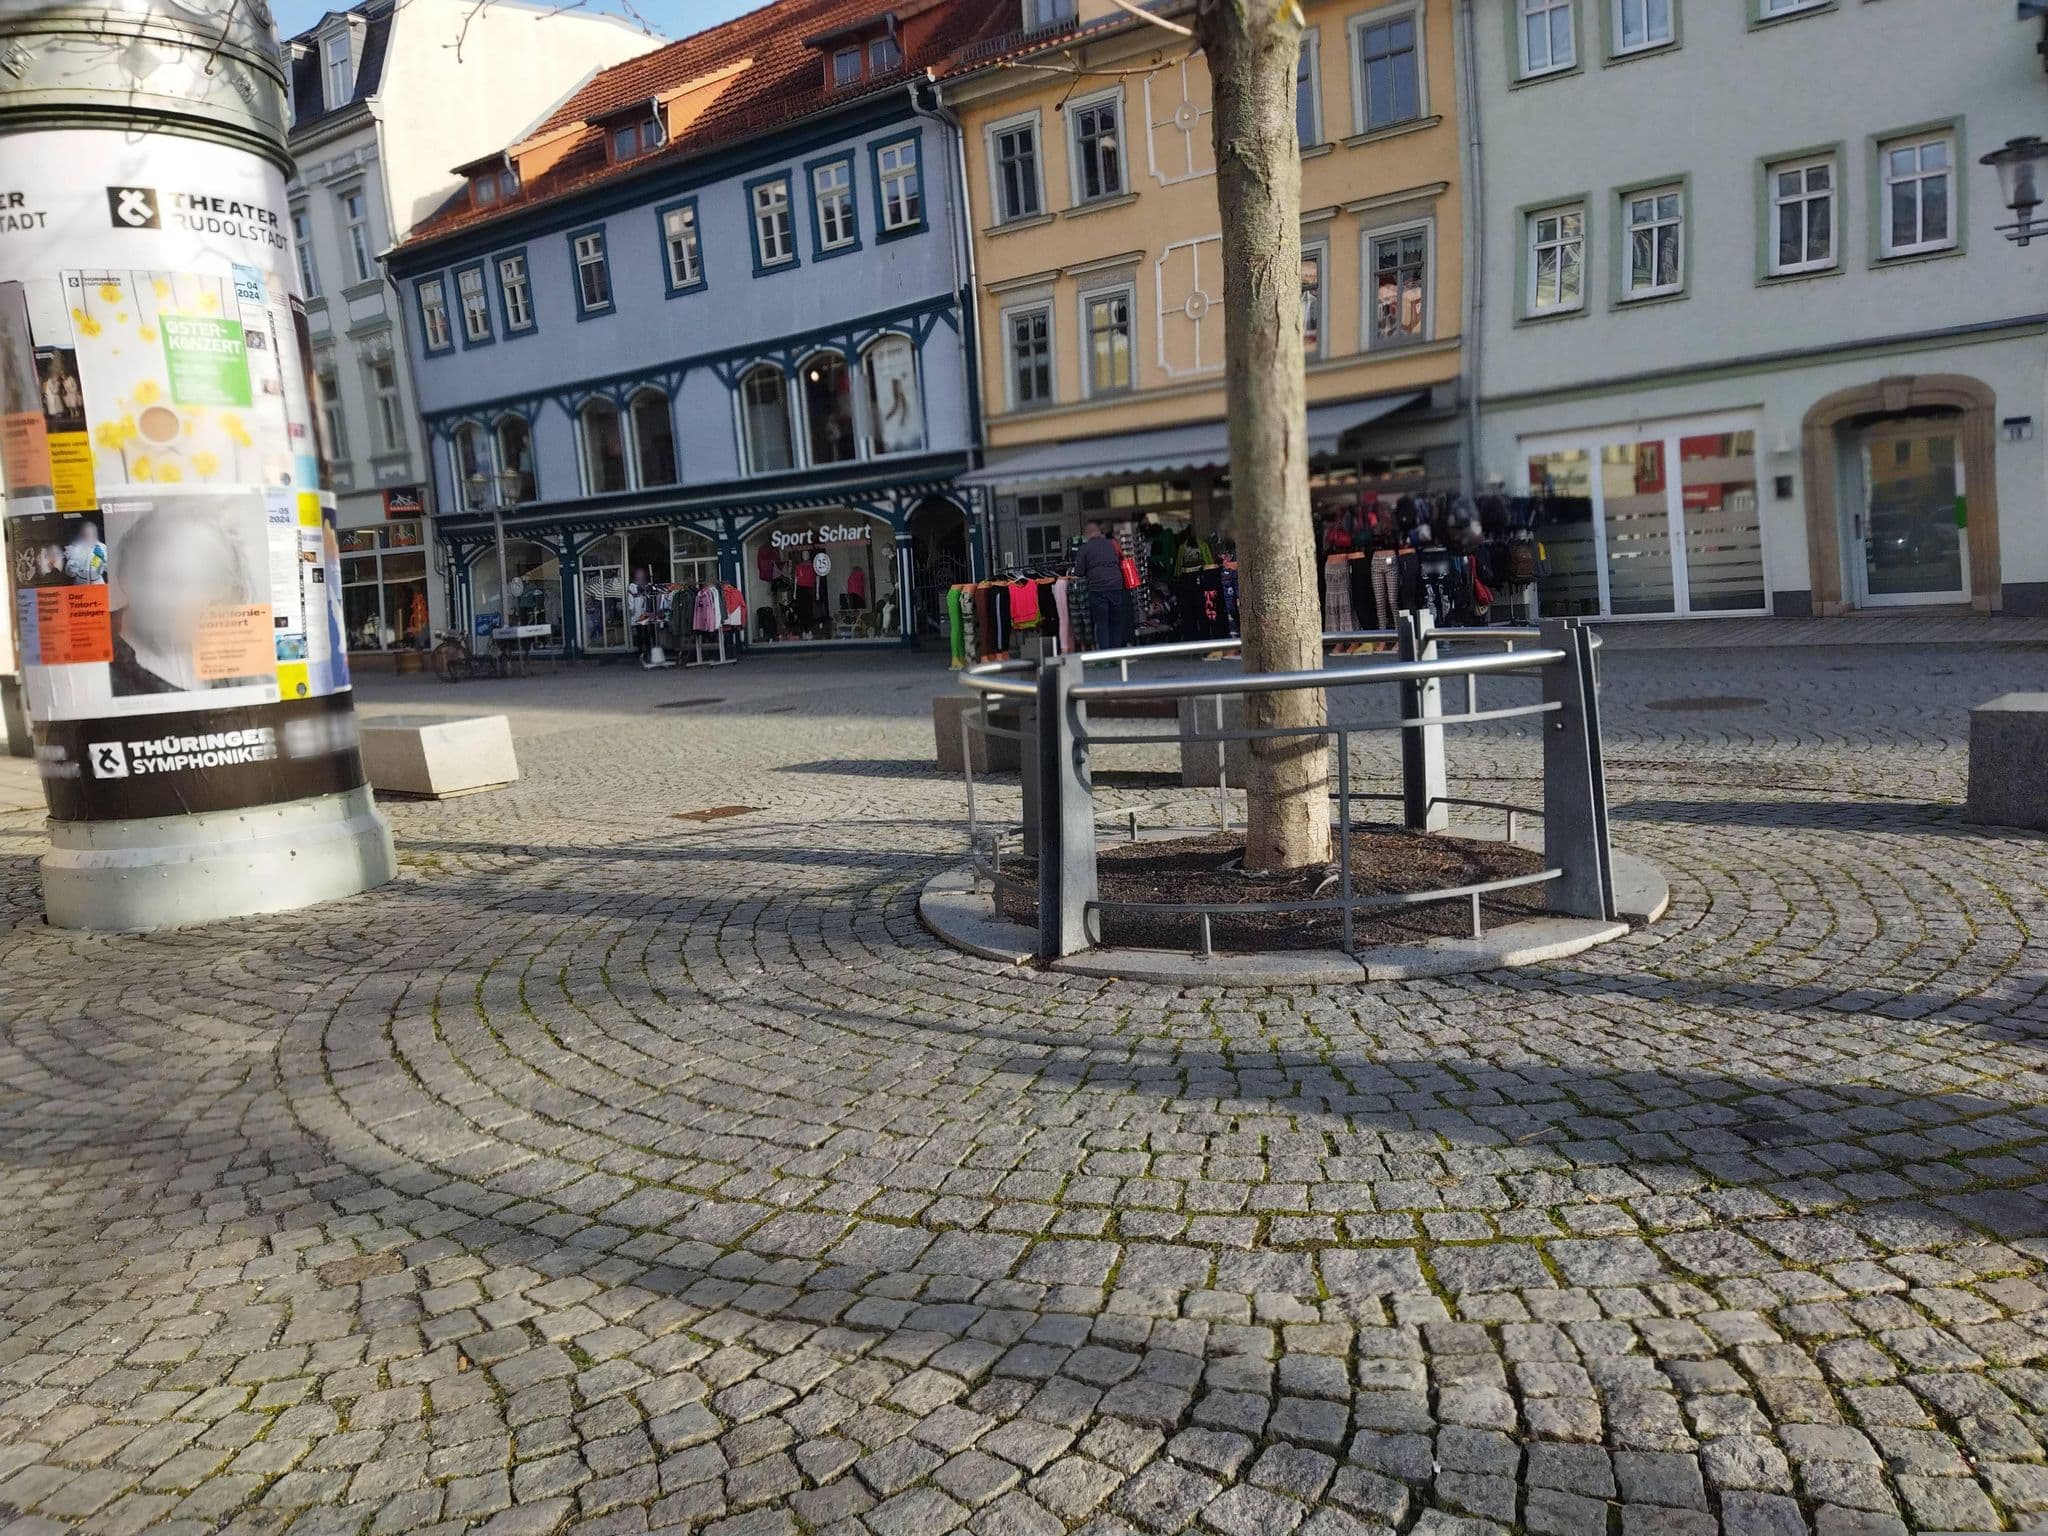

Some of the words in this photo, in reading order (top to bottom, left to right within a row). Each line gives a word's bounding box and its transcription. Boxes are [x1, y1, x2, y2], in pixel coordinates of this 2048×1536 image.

[168, 192, 278, 228] THEATER
[172, 213, 288, 252] RUDOLSTADT
[238, 289, 260, 300] 2024
[246, 281, 258, 290] 04
[166, 320, 228, 338] OSTER-
[168, 335, 241, 353] KONZERT
[269, 515, 290, 523] 2024
[278, 507, 289, 515] 05
[771, 529, 814, 550] Sport
[818, 524, 872, 543] Schart
[127, 727, 276, 757] THÜRINGER
[132, 744, 279, 775] SYMPHONIKER
